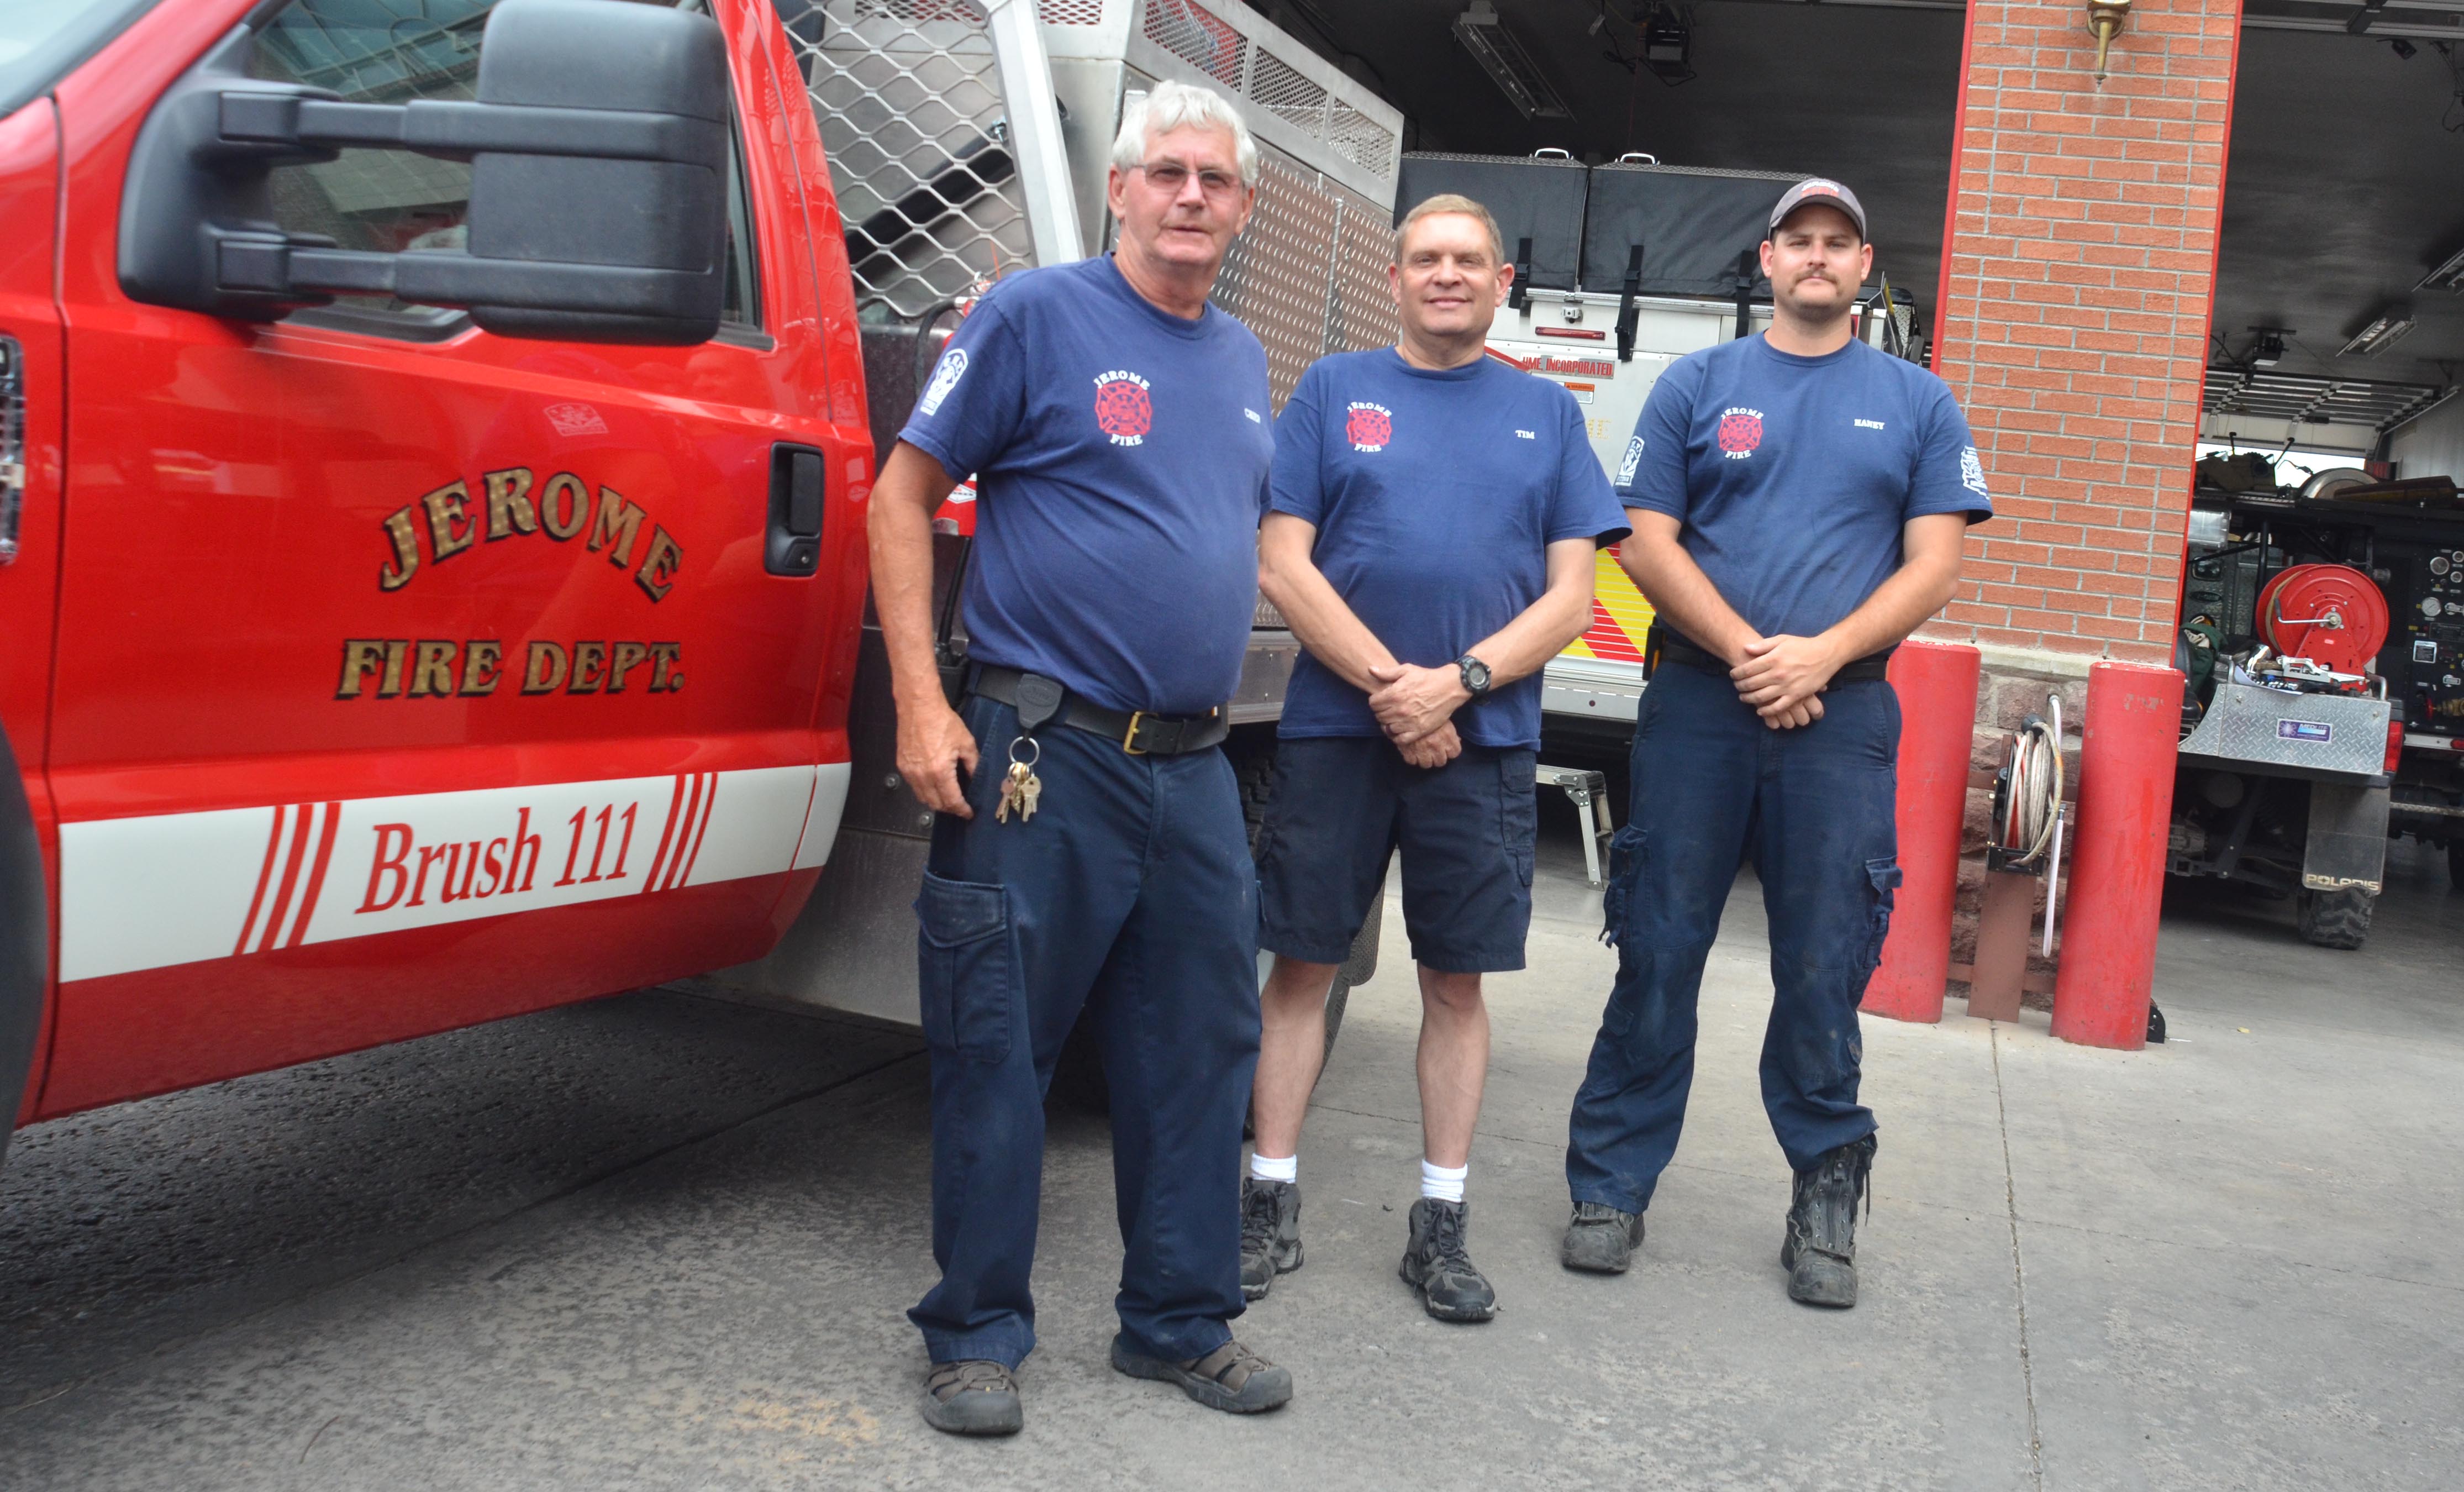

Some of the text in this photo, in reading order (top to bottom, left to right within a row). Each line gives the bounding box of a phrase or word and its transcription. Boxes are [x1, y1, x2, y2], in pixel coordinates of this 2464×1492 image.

[1546, 358, 1613, 376] INCORPORATED
[1093, 370, 1150, 390] JEROME
[1347, 402, 1392, 417] JEROME
[1720, 407, 1764, 420] JEROME
[1110, 433, 1143, 446] FIRE
[1515, 429, 1535, 439] TIM
[1354, 443, 1382, 452] FIRE
[1725, 449, 1751, 459] FIRE
[379, 467, 684, 603] JEROME
[334, 639, 685, 700] FIRE DEPT.
[354, 801, 639, 915] Brush 111
[2306, 874, 2379, 891] POLARIS
